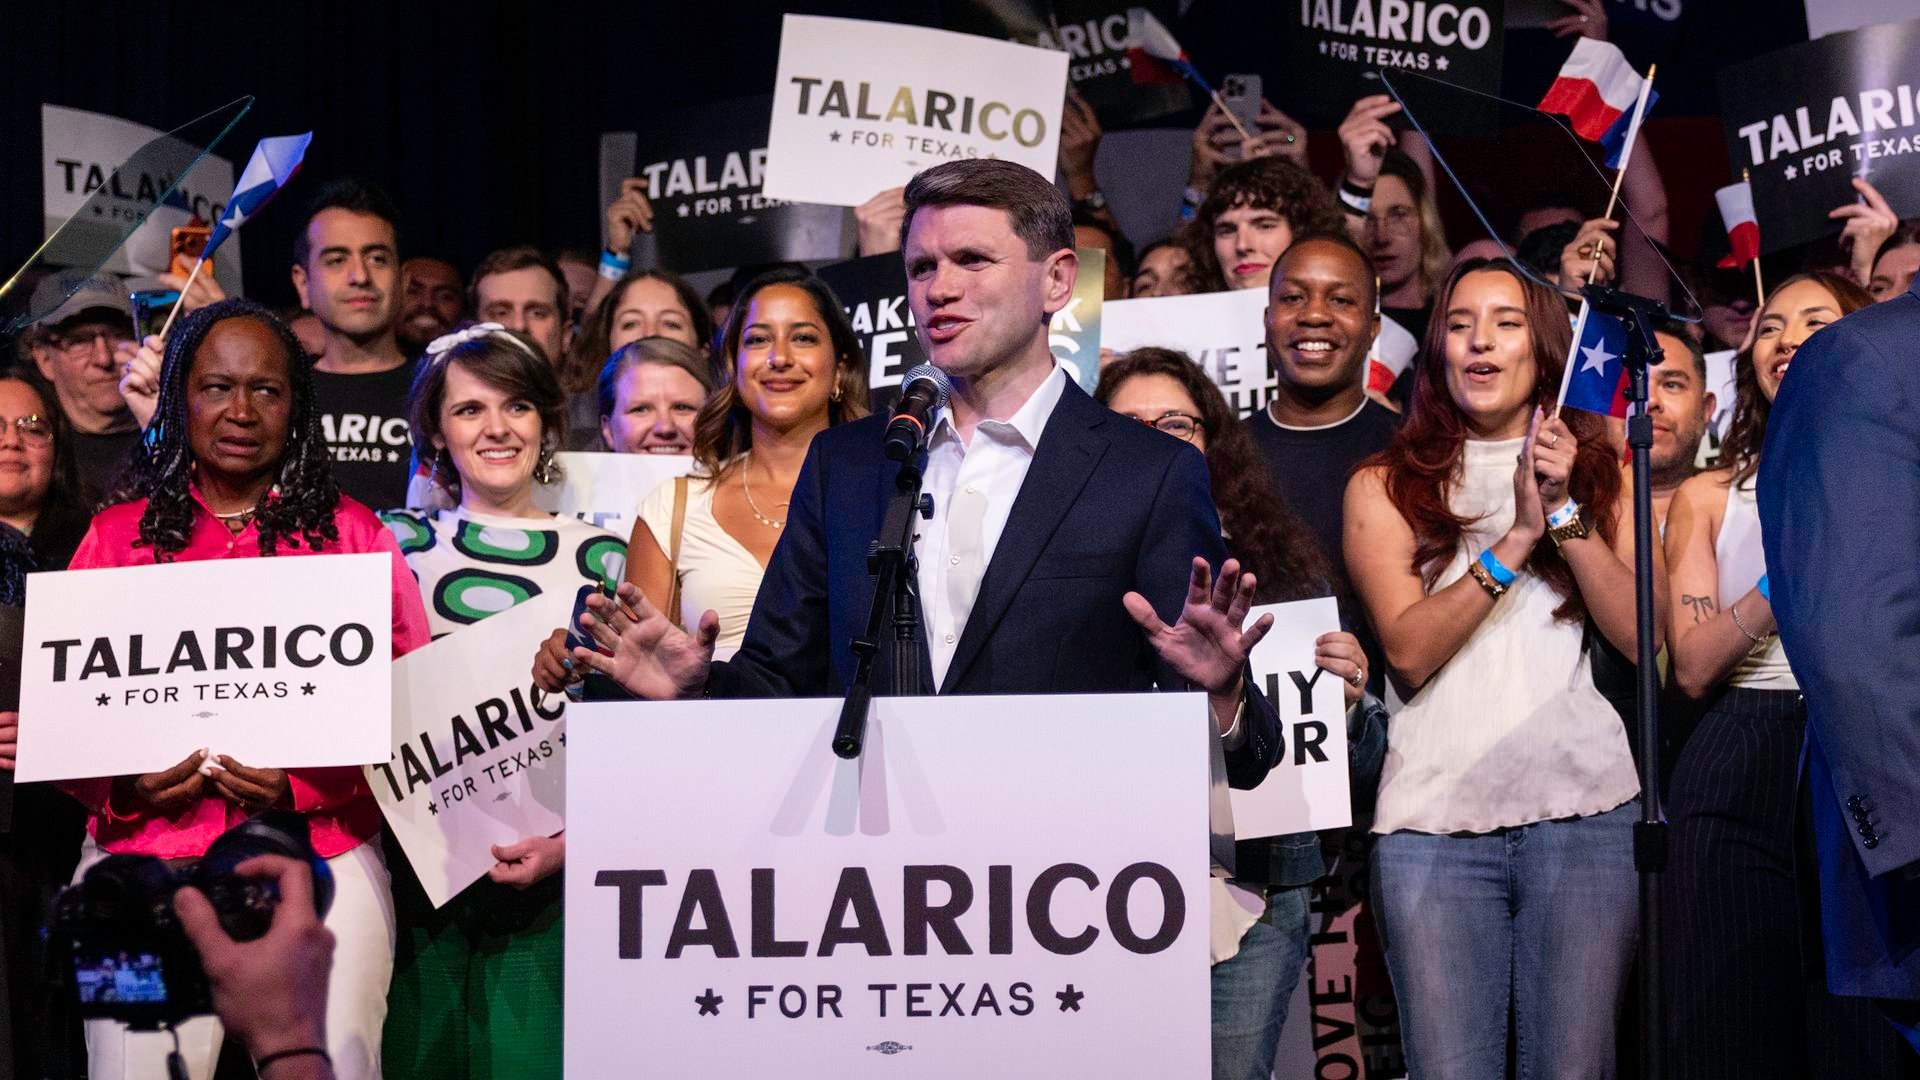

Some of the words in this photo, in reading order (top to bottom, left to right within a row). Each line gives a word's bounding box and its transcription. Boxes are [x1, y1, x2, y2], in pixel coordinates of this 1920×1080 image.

[1330, 41, 1358, 62] FOR
[1363, 46, 1430, 70] TEXAS
[791, 76, 1046, 148] TALARICO
[1738, 84, 1920, 166] TALARI
[851, 130, 894, 149] FOR
[905, 135, 979, 160] TEXAS
[1802, 149, 1844, 177] FOR
[694, 197, 732, 217] FOR
[41, 622, 375, 682] TALARICO
[125, 686, 180, 706] FOR
[193, 681, 289, 701] TEXAS
[440, 776, 478, 809] FOR
[482, 740, 553, 785] TEXAS
[594, 861, 1187, 960] TALARICO
[747, 984, 844, 1019] FOR
[868, 981, 1036, 1018] TEXAS
